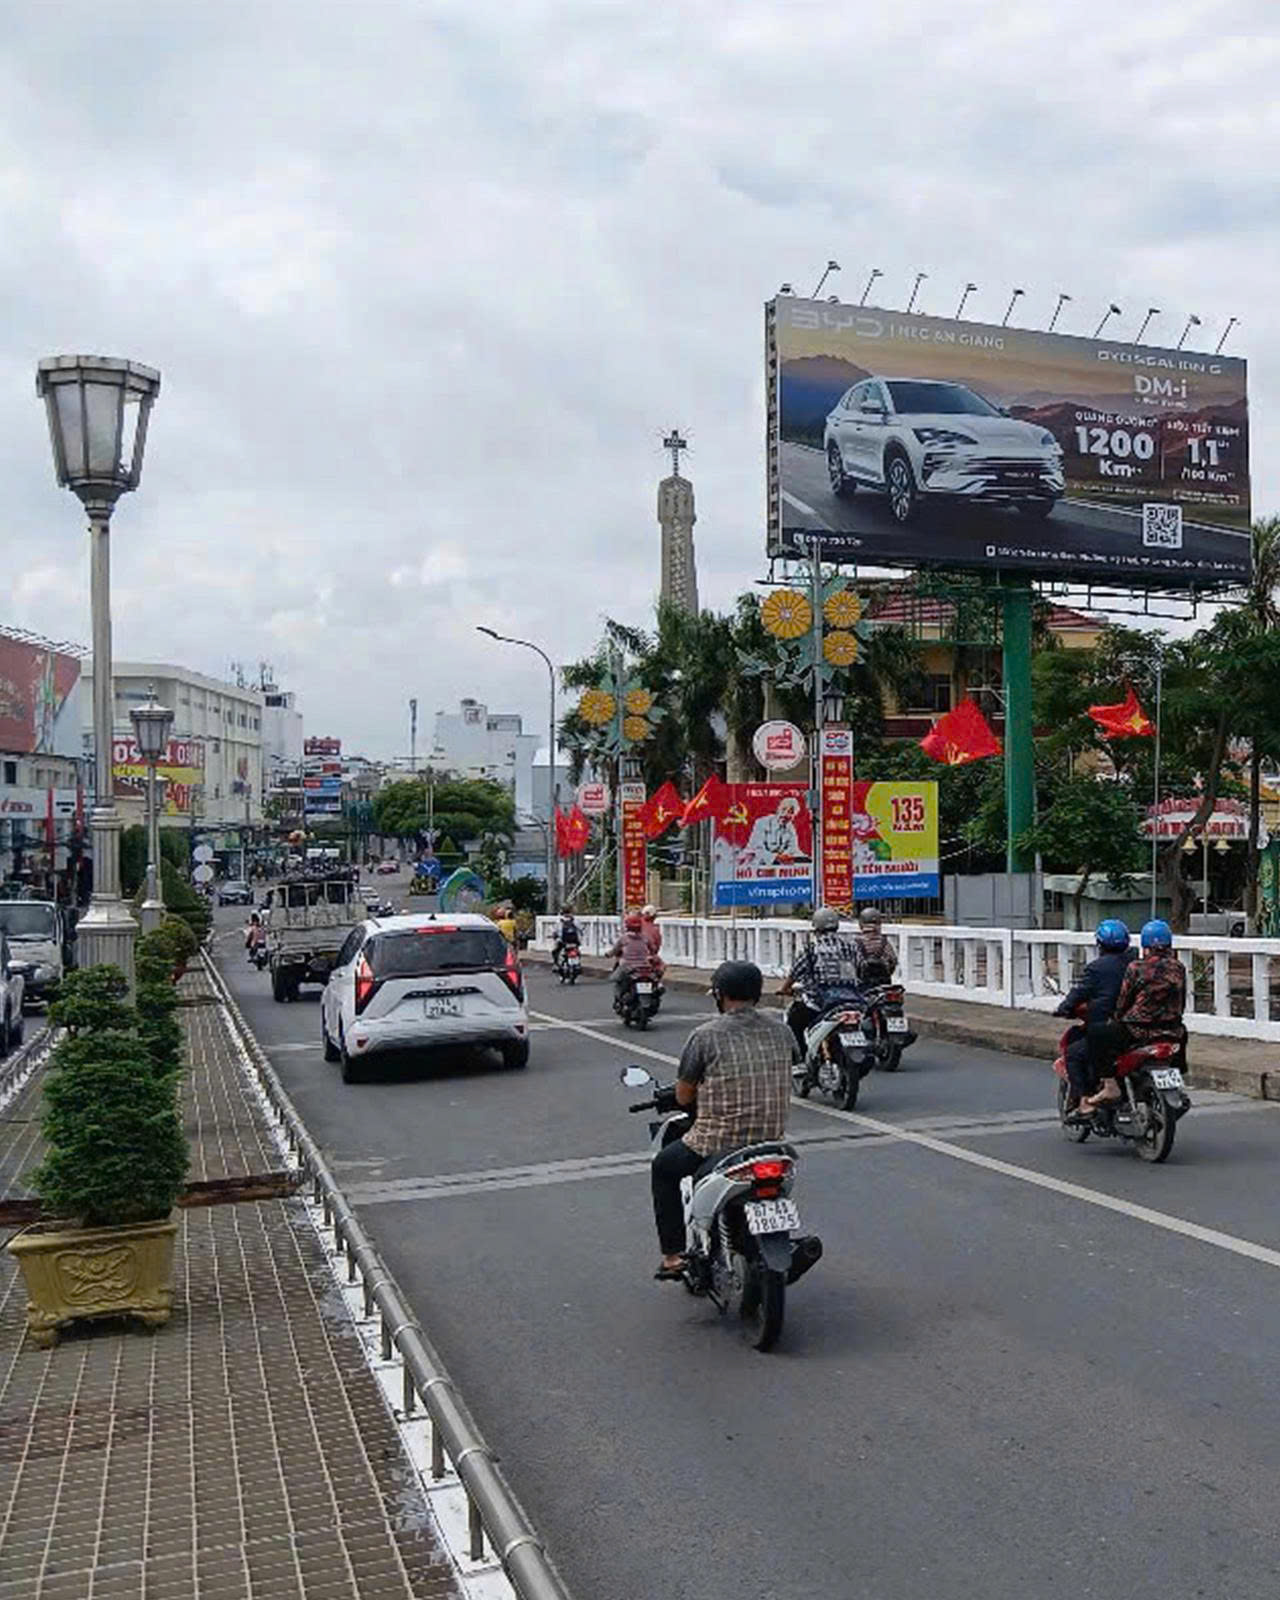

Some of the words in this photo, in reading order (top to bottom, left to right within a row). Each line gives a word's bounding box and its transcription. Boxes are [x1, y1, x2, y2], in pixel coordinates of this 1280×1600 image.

[791, 308, 884, 337] BYD
[959, 333, 1005, 351] GIANG
[1134, 374, 1187, 399] DM-i
[1075, 426, 1154, 460] 1200
[1188, 438, 1218, 468] 1,1
[891, 798, 925, 822] 135
